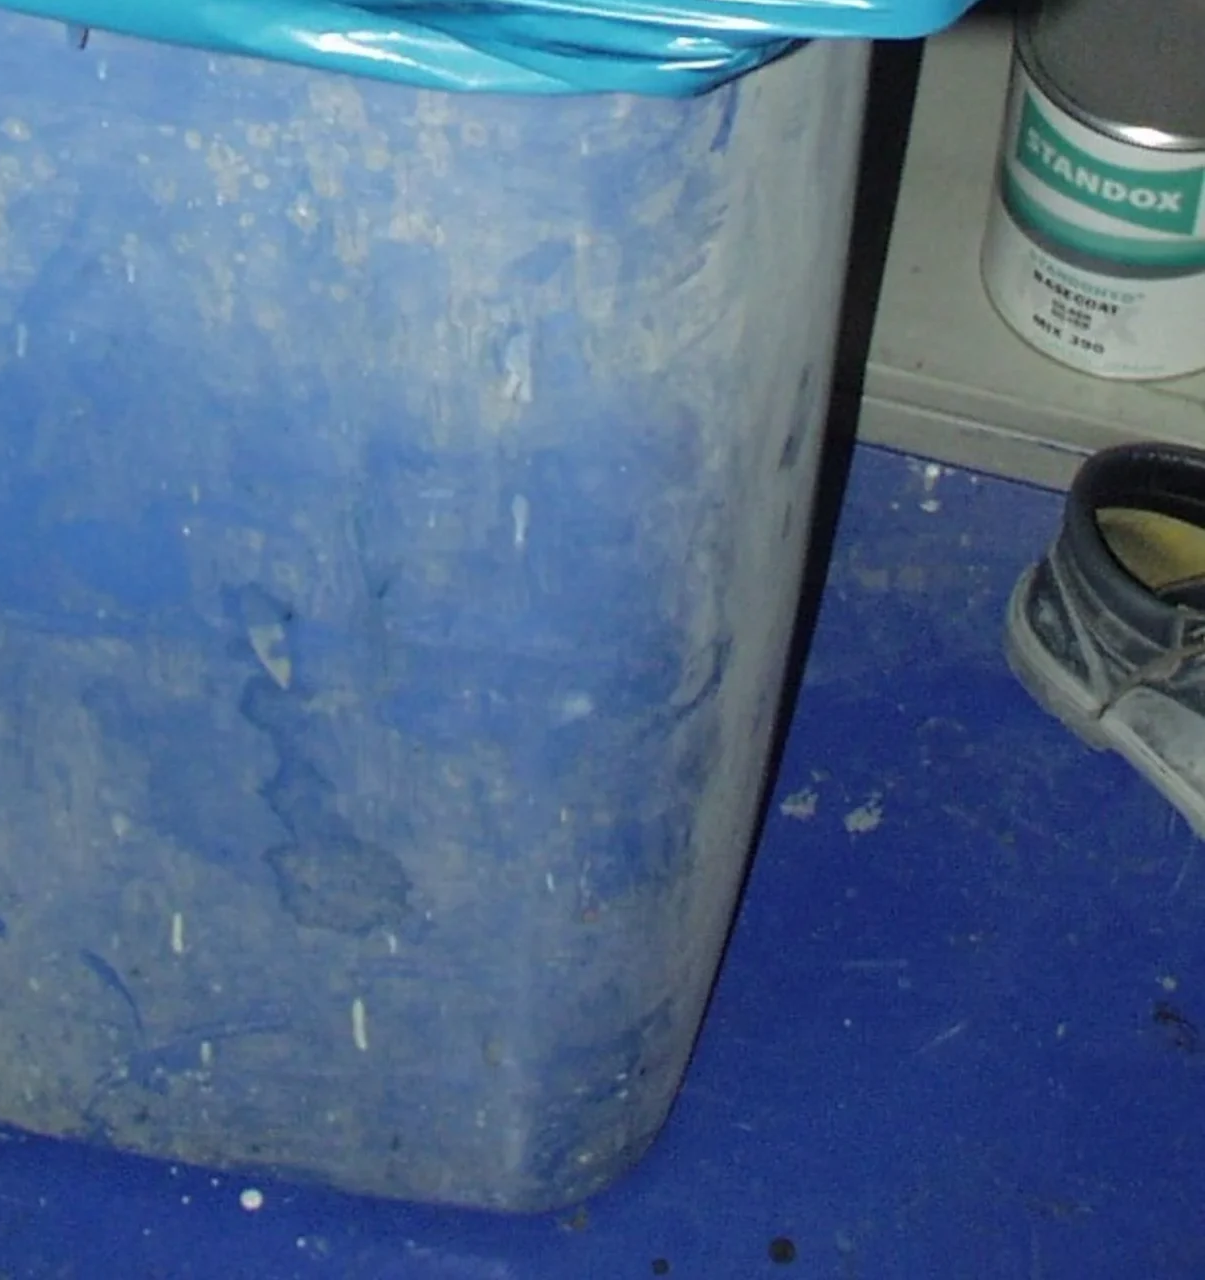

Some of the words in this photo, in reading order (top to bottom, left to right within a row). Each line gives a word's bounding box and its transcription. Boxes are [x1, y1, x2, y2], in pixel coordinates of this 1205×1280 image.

[1027, 125, 1184, 213] STANDOX
[1032, 313, 1062, 339] MIX
[1070, 333, 1106, 355] 390
